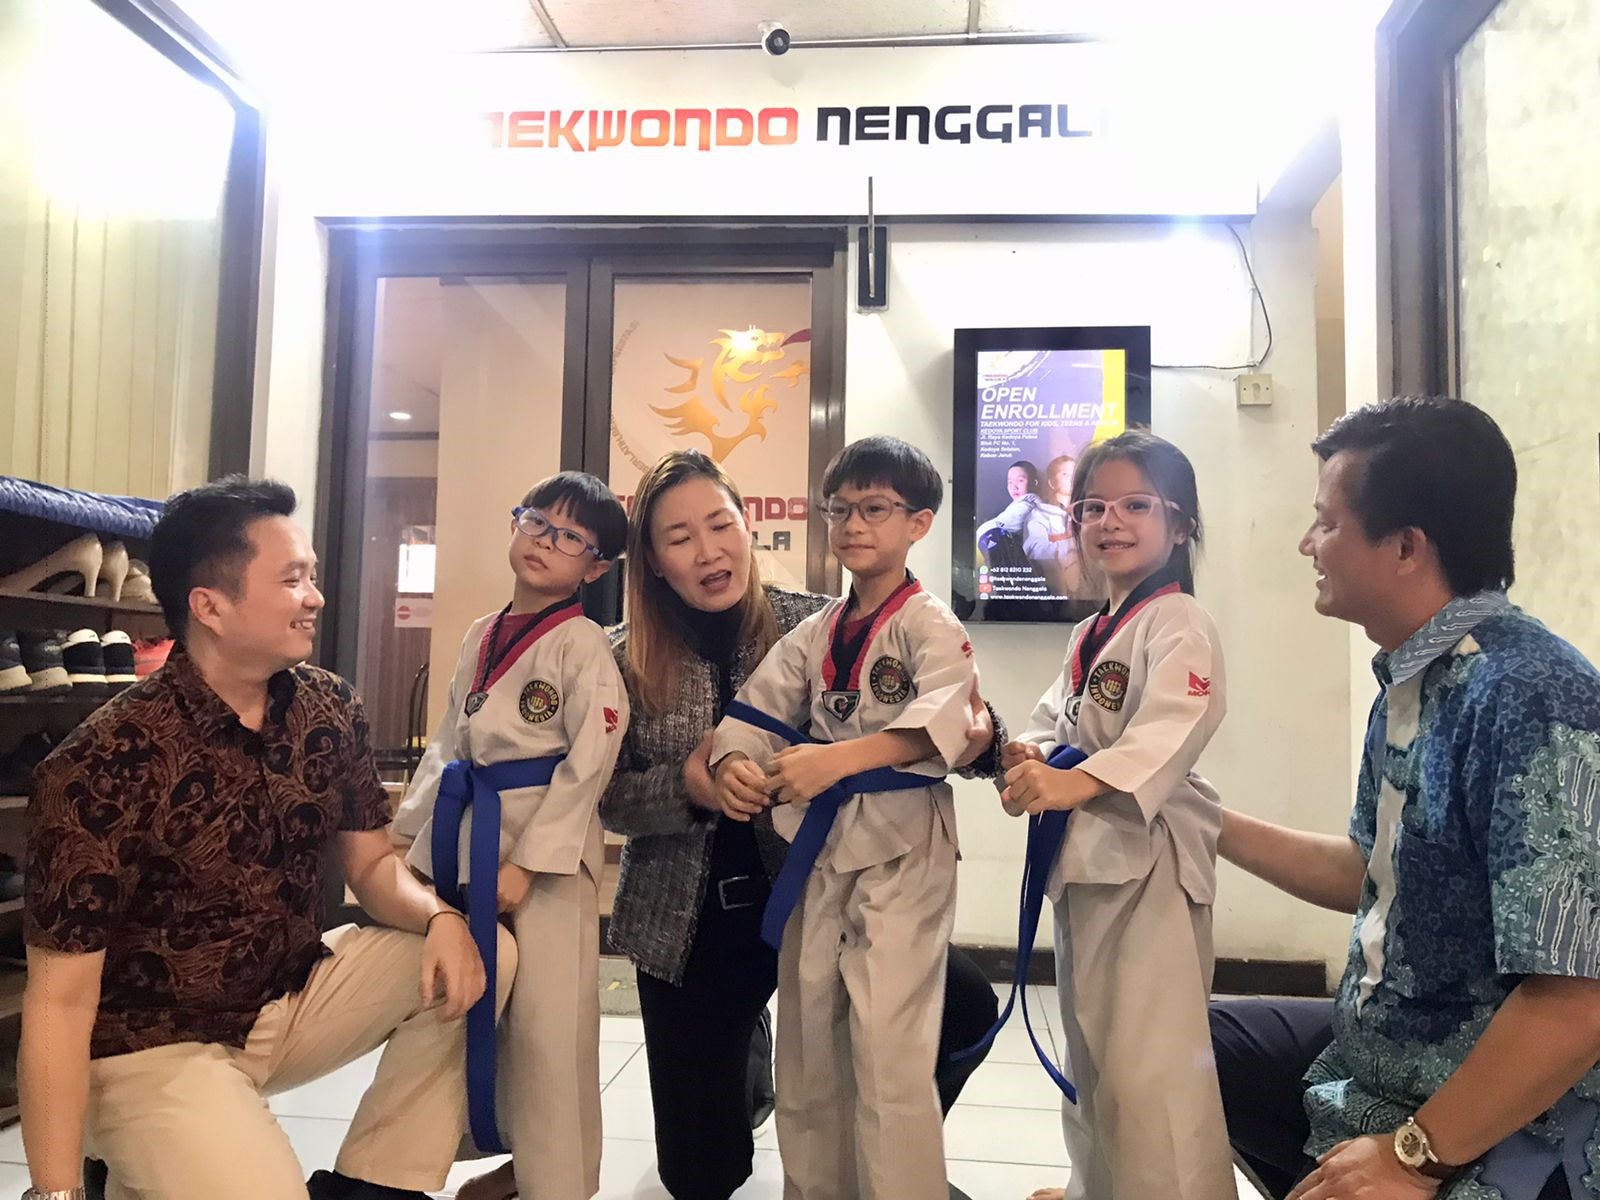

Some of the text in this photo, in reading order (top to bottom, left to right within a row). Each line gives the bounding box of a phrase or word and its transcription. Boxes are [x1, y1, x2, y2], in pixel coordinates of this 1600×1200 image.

[480, 104, 1093, 152] EKWONDO NENGGAL
[981, 387, 1037, 402] OPEN
[980, 402, 1119, 420] ENROLLMENT
